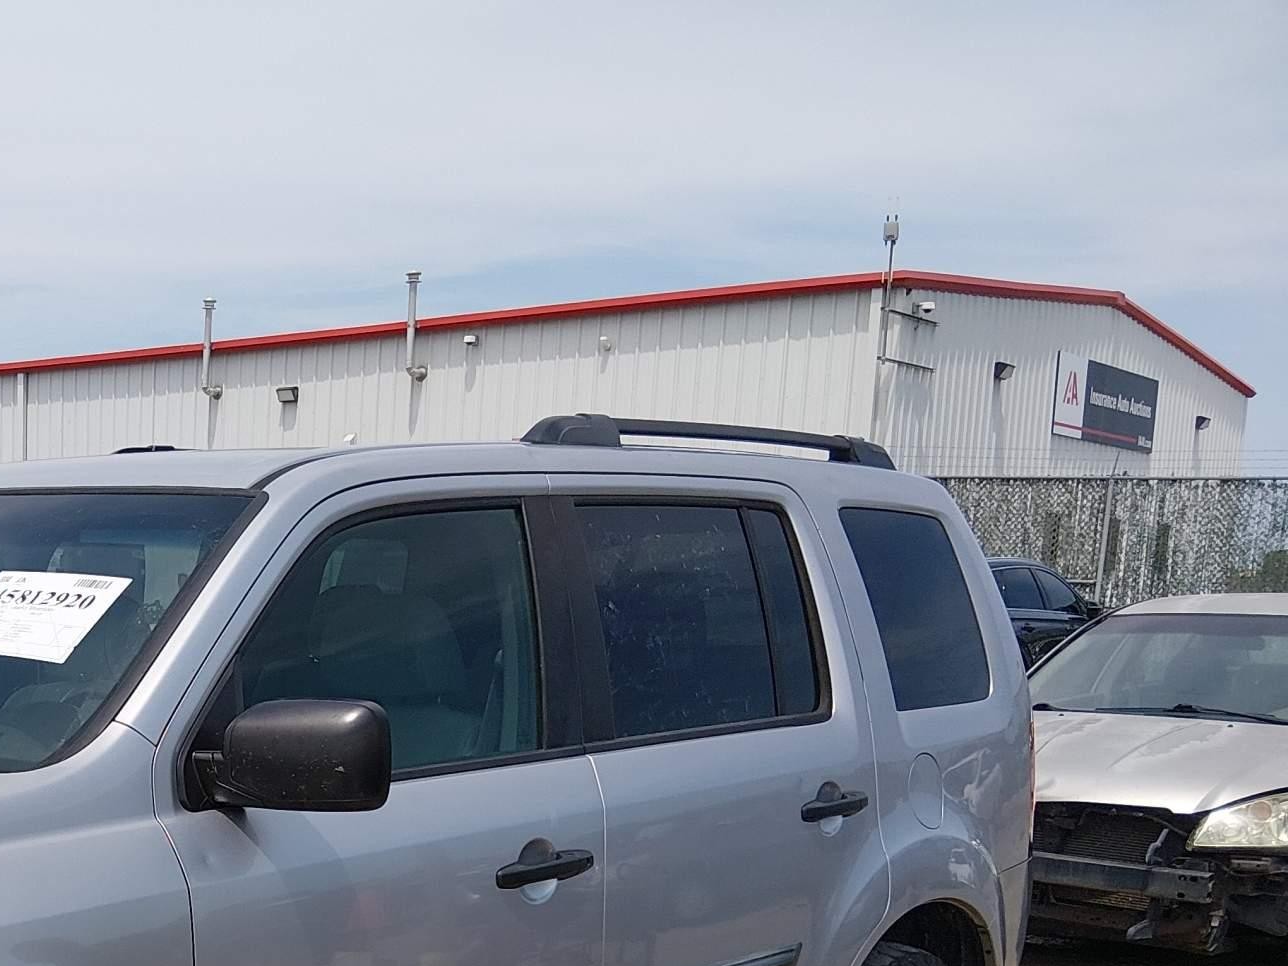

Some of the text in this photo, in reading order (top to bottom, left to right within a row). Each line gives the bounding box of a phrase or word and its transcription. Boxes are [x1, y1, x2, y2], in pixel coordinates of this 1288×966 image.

[1090, 387, 1151, 418] Insurance Auto Auctions
